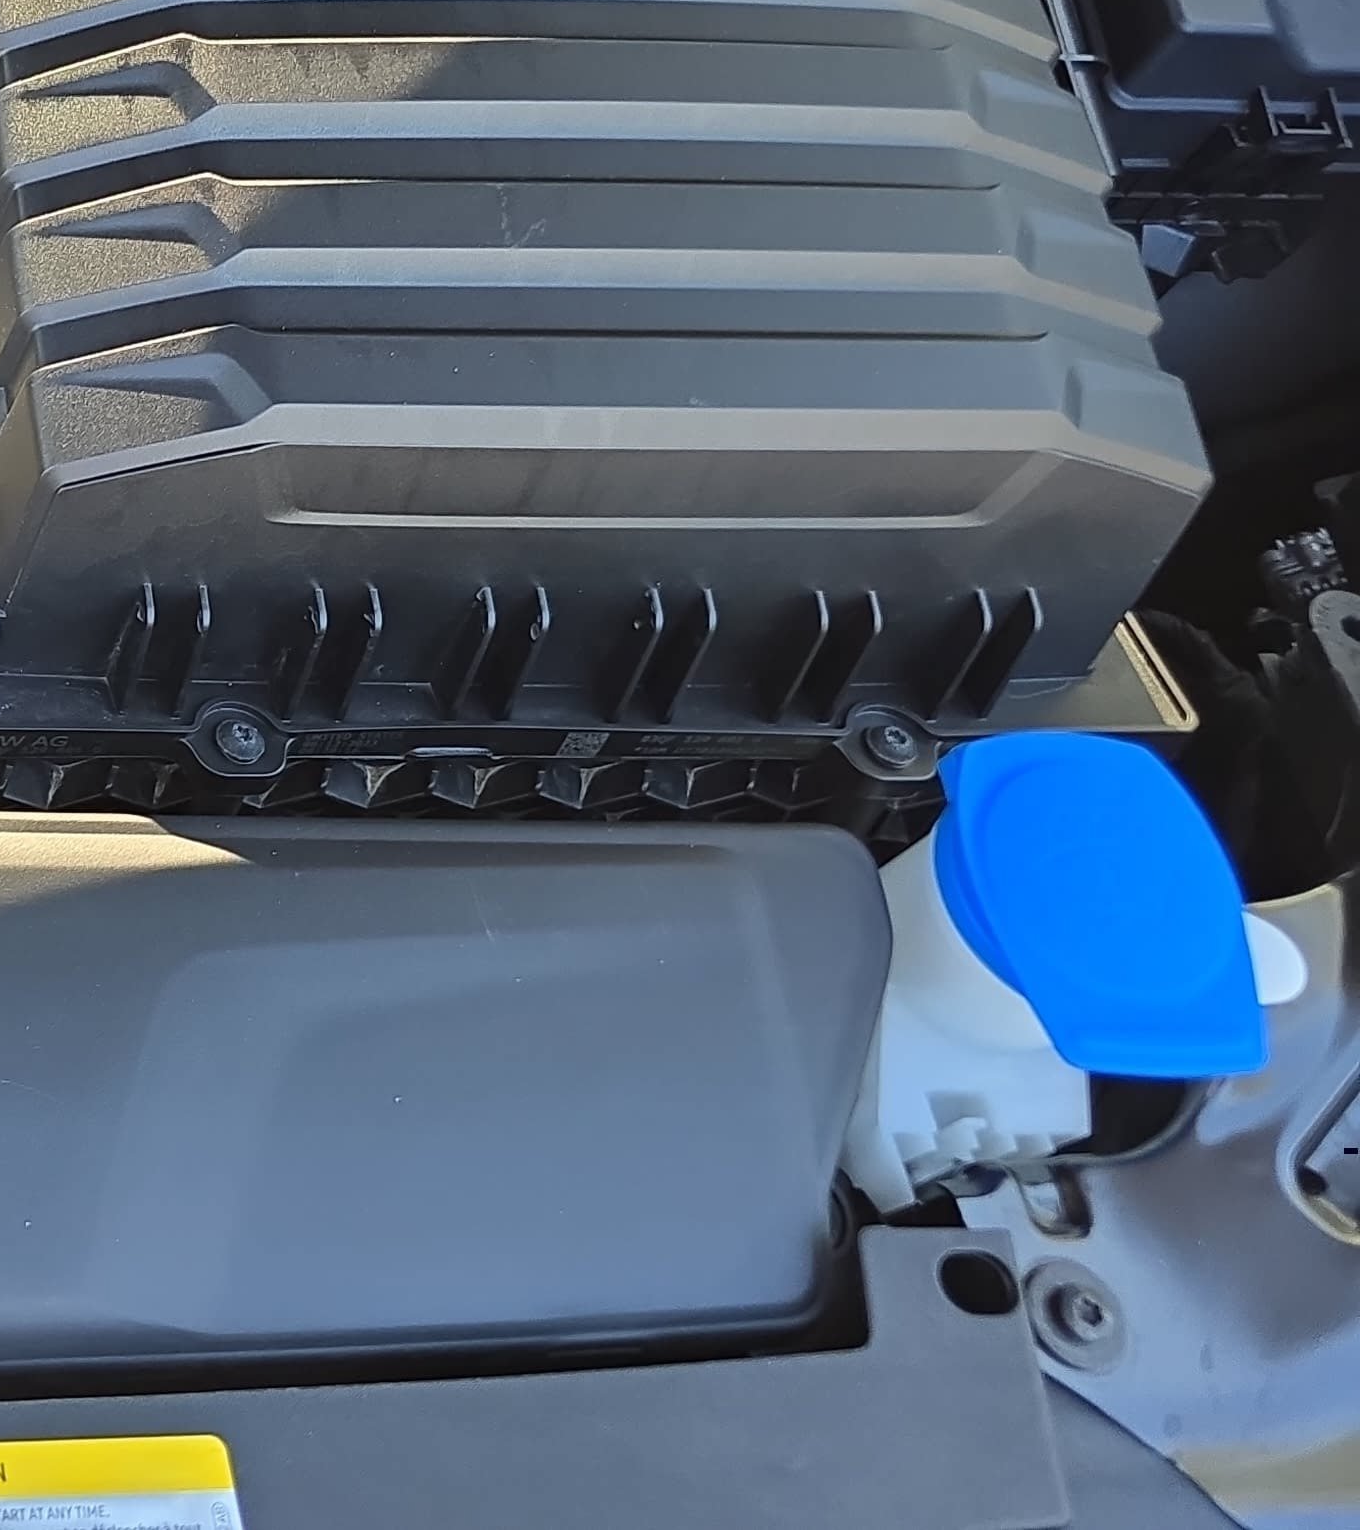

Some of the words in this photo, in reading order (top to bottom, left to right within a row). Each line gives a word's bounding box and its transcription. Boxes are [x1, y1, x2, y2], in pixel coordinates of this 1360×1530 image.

[31, 735, 68, 747] AG
[29, 1507, 43, 1520] AT
[47, 1506, 73, 1520] ANY
[74, 1505, 110, 1518] TIME.
